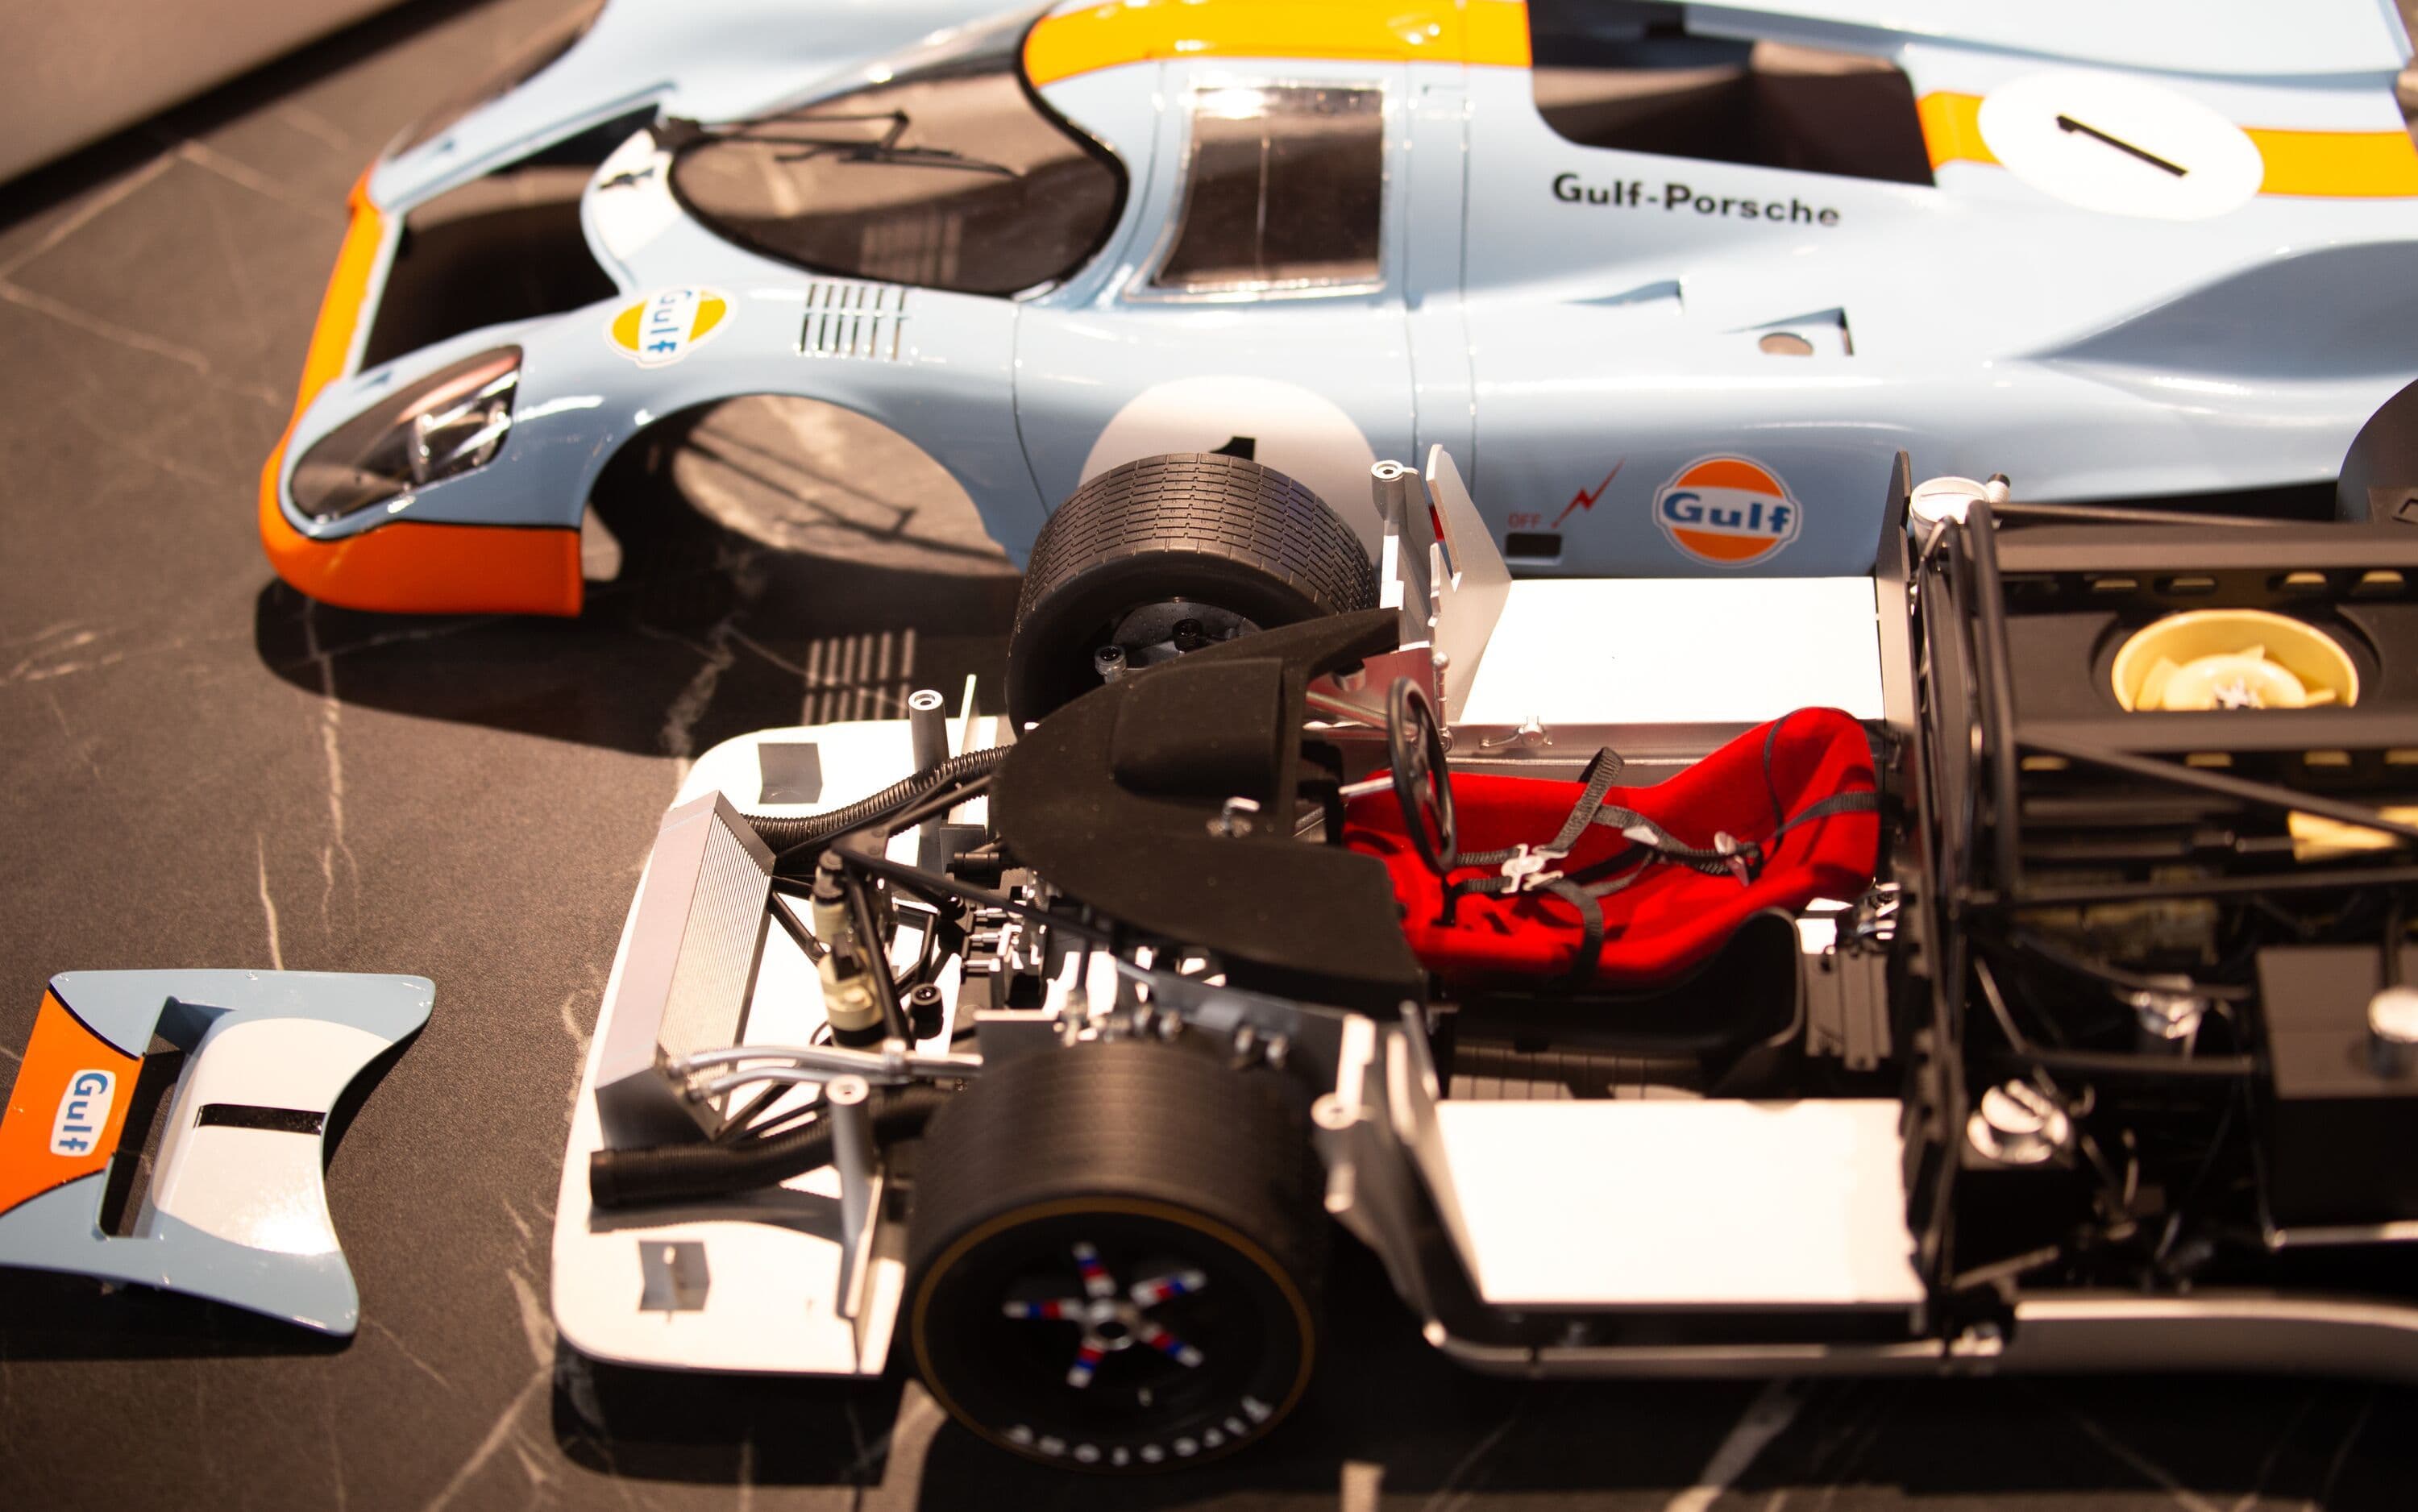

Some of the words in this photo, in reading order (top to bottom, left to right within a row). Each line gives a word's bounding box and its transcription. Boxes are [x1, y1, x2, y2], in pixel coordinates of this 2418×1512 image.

[2055, 114, 2188, 177] 1
[1552, 172, 1840, 226] Gulf-Porsche
[647, 289, 692, 352] Gulf
[1663, 492, 1792, 533] Gulf
[58, 1073, 108, 1152] Gulf
